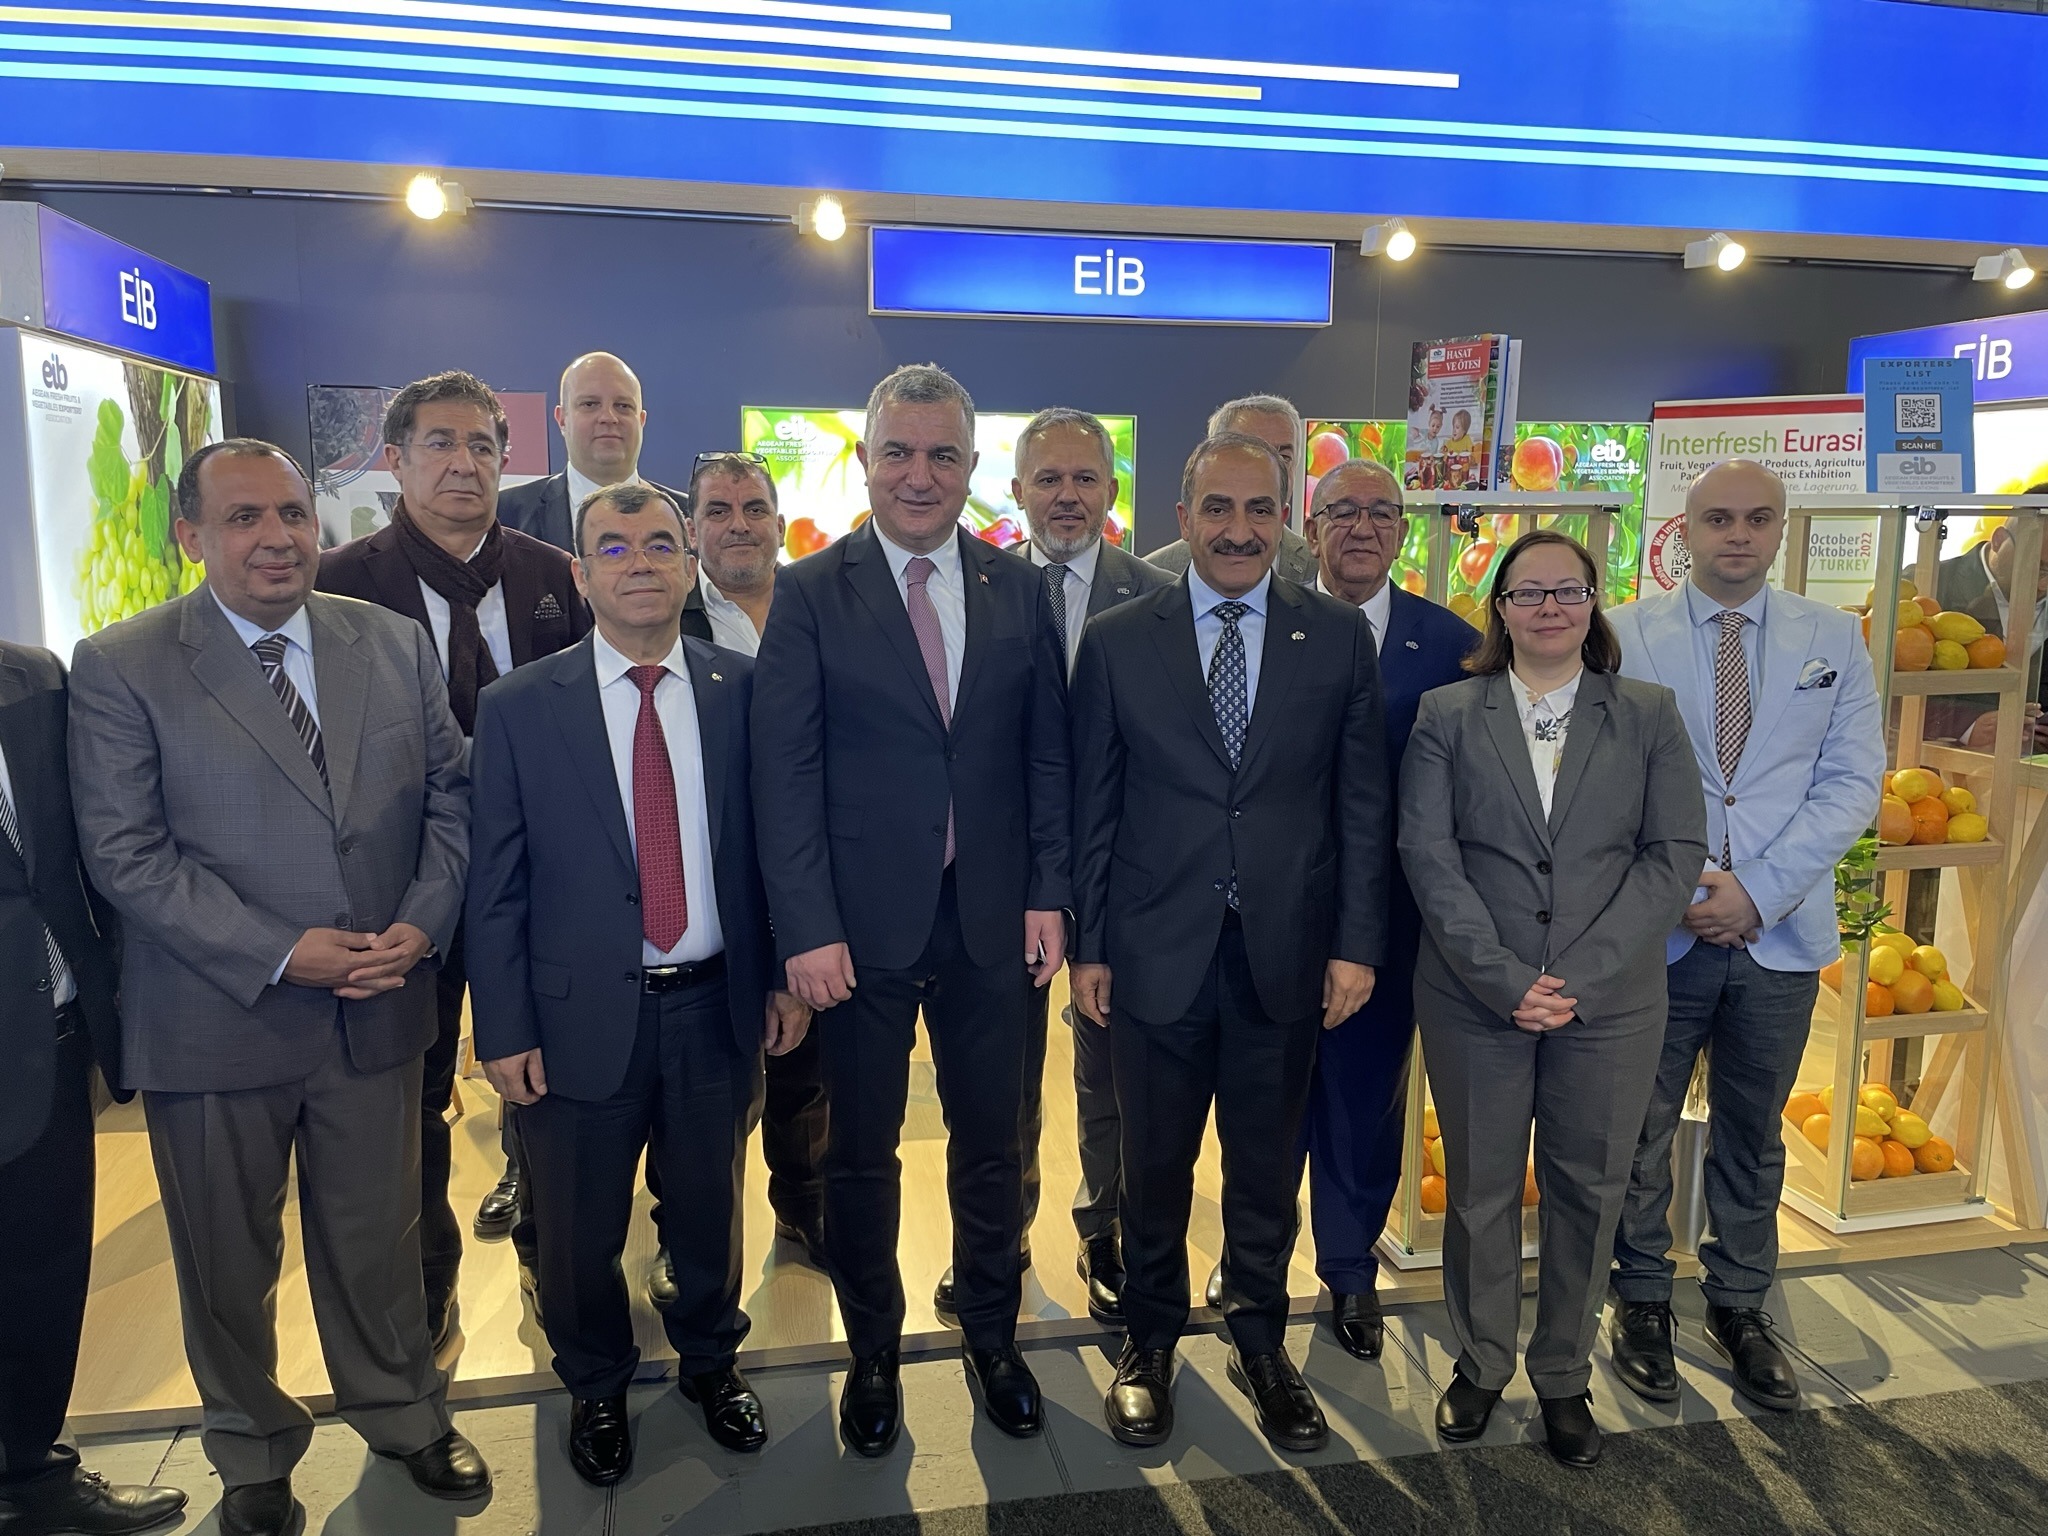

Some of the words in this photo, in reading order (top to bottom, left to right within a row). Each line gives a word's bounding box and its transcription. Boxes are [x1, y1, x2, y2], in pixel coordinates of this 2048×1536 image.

[1074, 248, 1146, 297] EİB
[119, 267, 157, 330] EİB
[1446, 348, 1473, 360] HASAT
[42, 352, 68, 391] eib
[1446, 361, 1457, 371] VE
[1659, 430, 1777, 456] Interfresh
[1784, 427, 1864, 453] Eurasi
[1902, 442, 1923, 450] SCAN
[1591, 439, 1626, 462] eib
[1660, 461, 1685, 471] Fruit,
[1765, 459, 1812, 469] Products,
[1899, 456, 1936, 475] eib
[1799, 470, 1851, 479] Exhibition
[1653, 535, 1666, 547] We
[1809, 546, 1860, 557] Oktober
[1860, 532, 1872, 557] 2022
[1811, 533, 1861, 545] October
[1651, 555, 1661, 566] ein
[1820, 559, 1869, 571] TURKEY
